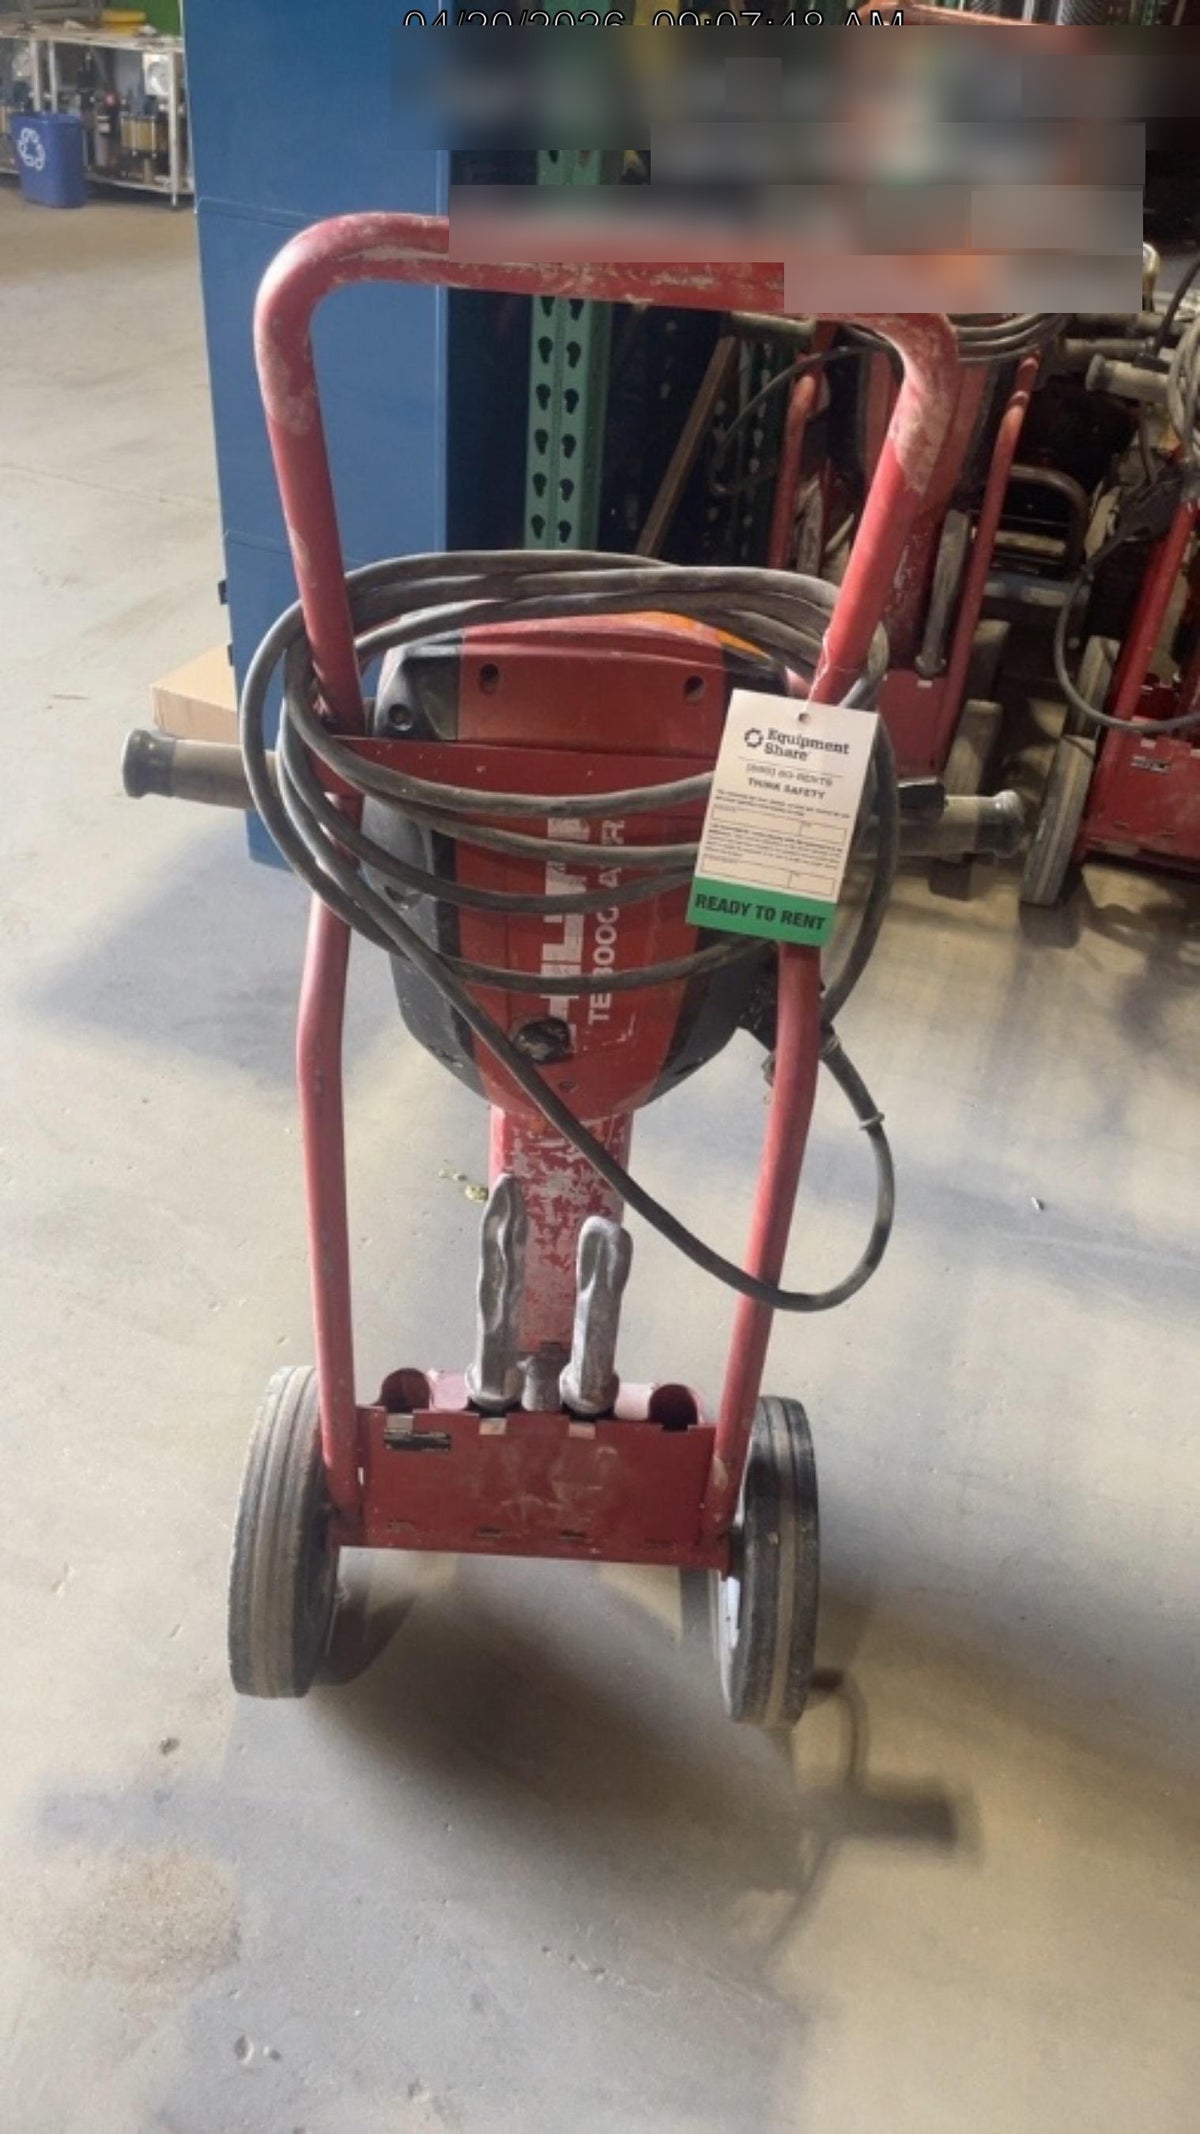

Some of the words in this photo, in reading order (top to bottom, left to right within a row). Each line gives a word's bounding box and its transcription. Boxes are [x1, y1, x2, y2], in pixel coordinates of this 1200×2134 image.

[764, 742, 808, 761] Share
[767, 728, 849, 754] Equipment
[784, 785, 826, 800] SAFETY
[695, 893, 752, 917] READY
[755, 904, 777, 922] TO
[780, 909, 827, 931] RENT
[587, 992, 612, 1025] TE
